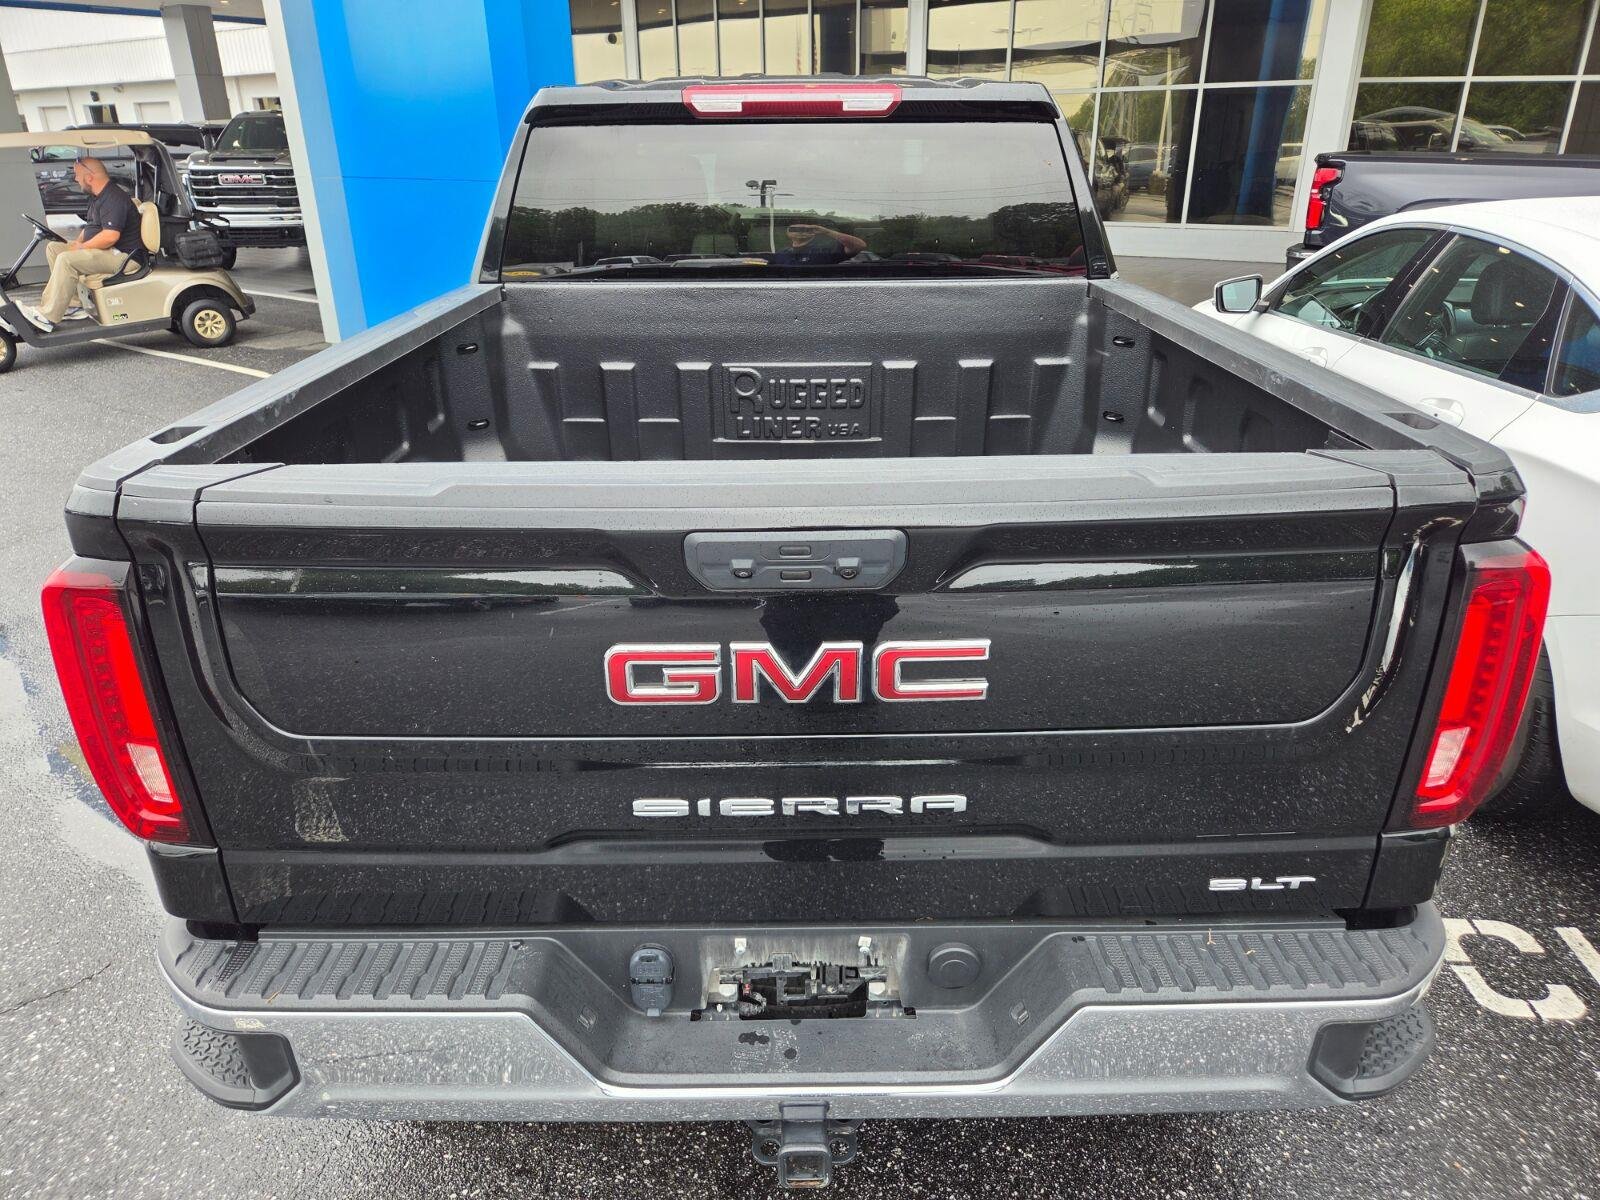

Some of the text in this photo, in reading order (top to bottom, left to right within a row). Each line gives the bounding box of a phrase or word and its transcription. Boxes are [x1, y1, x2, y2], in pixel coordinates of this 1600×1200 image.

[729, 366, 866, 414] RUGGED
[736, 416, 863, 439] LINER USA
[604, 639, 992, 706] GMC
[632, 794, 967, 817] SIERRA
[1208, 875, 1317, 891] SLT
